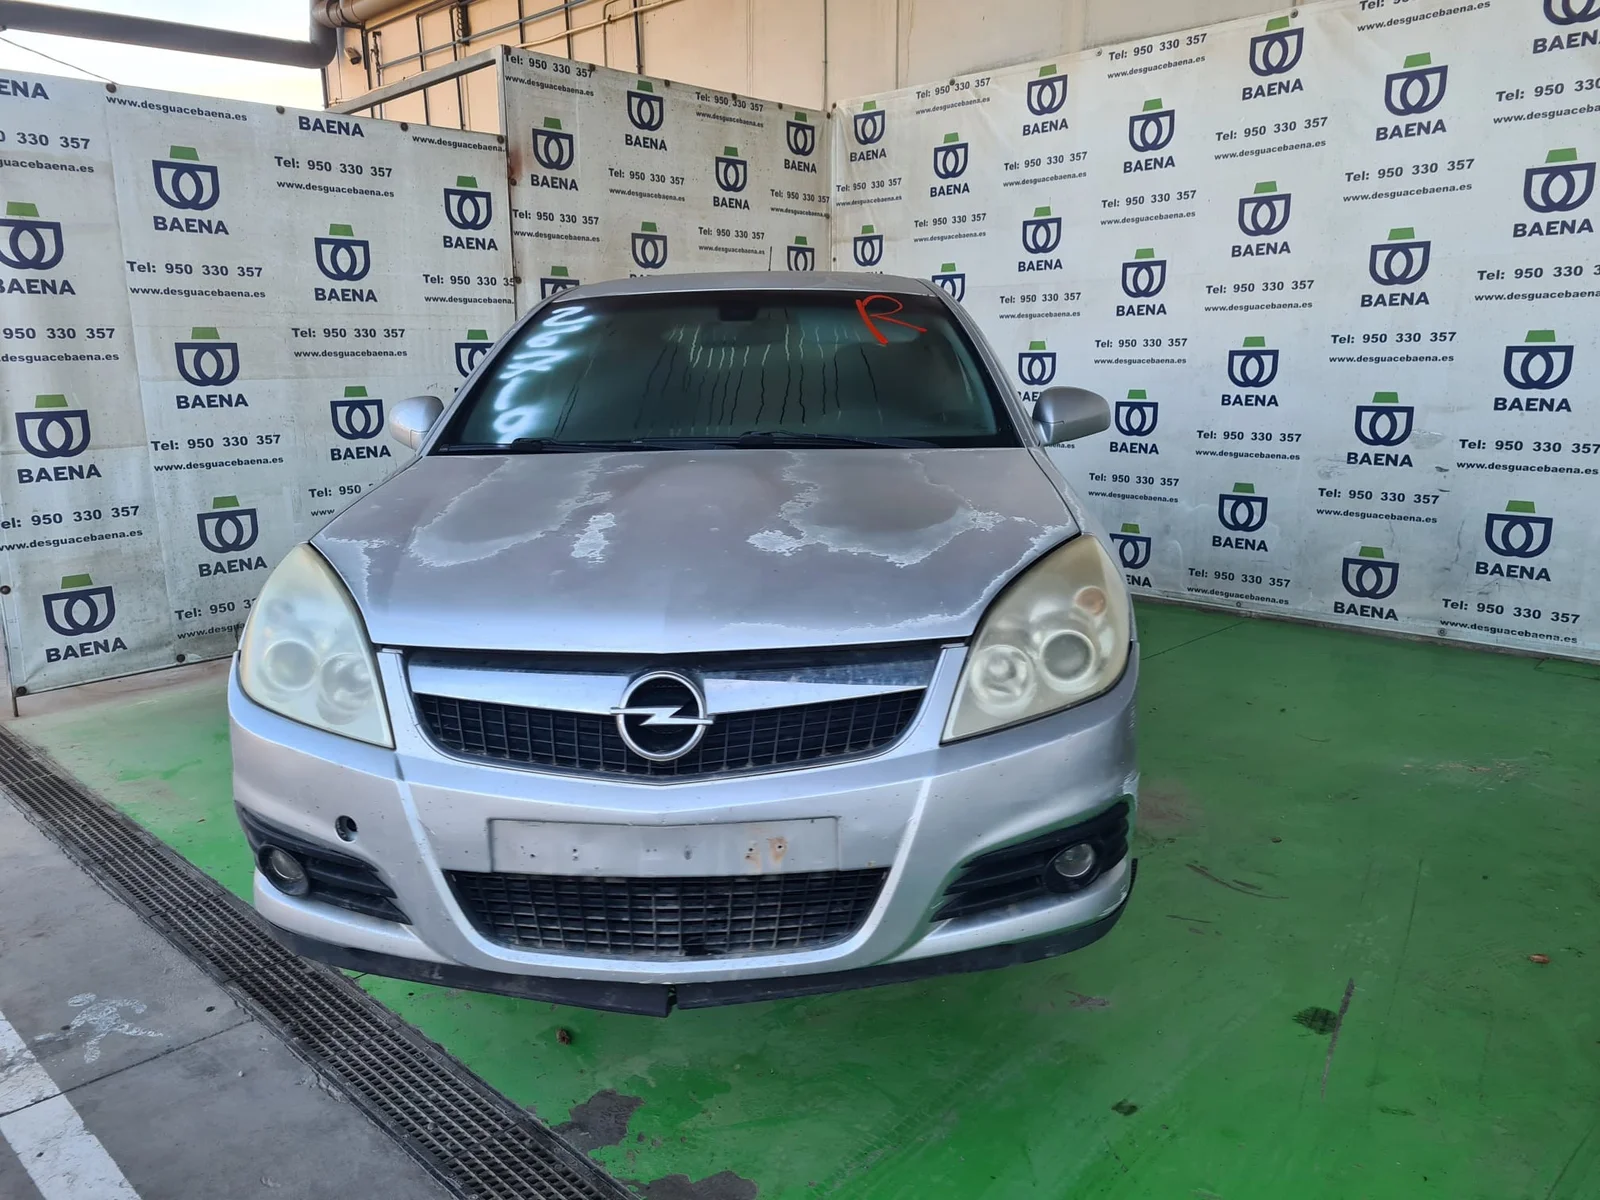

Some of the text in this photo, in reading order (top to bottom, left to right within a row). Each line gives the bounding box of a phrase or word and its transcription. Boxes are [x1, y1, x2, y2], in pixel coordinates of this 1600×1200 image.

[1358, 2, 1490, 31] www.desguacebaena.es
[1109, 33, 1207, 60] Tel: 950 330 357
[1533, 29, 1600, 54] BAEN
[1108, 56, 1205, 78] www.desguacebaena.es
[1242, 78, 1303, 100] BAENA
[1496, 78, 1600, 102] Tel: 950 330
[106, 96, 247, 121] www.desguacebaena.es
[298, 116, 364, 137] BAENA
[1023, 118, 1068, 136] BAENA
[1216, 117, 1328, 141] Tel: 950 330 357
[1376, 119, 1446, 141] BAENA
[625, 134, 667, 151] BAENA
[1214, 141, 1326, 160] www.desguacebaena.es
[850, 148, 886, 162] BAENA
[1004, 152, 1087, 170] Tel: 950 330 357
[274, 156, 392, 178] Tel: 950 330 357
[784, 159, 817, 174] BAENA
[1124, 156, 1175, 173] BAENA
[1345, 159, 1474, 182] Tel: 950 330 357
[531, 174, 578, 191] BAENA
[608, 168, 684, 185] Tel: 950 330 357
[1003, 172, 1086, 186] www.desguacebaena.es
[277, 182, 394, 197] www.desguacebaena.es
[930, 182, 970, 197] BAENA
[1343, 184, 1472, 202] www.desguacebaena.es
[713, 196, 750, 210] BAENA
[1102, 190, 1196, 208] Tel: 950 330 357
[512, 209, 599, 225] Tel: 950 330 357
[1101, 212, 1195, 225] www.desguacebaena.es
[153, 216, 229, 235] BAENA
[1513, 218, 1594, 238] BAENA
[443, 236, 498, 251] BAENA
[1232, 242, 1290, 258] BAENA
[126, 261, 262, 277] Tel: 950 330 357
[1018, 259, 1062, 272] BAENA
[1477, 266, 1583, 280] Tel: 950 330
[130, 287, 265, 298] www.desguacebaena.es
[314, 288, 378, 302] BAENA
[1206, 280, 1314, 294] Tel: 950 330 357
[1205, 302, 1312, 312] www.desguacebaena.es
[1361, 292, 1429, 307] BAENA
[1116, 304, 1166, 316] BAENA
[3, 328, 115, 339] 950 330 357
[291, 328, 405, 338] Tel: 950 330 357
[1331, 332, 1456, 344] Tel: 950 330 357
[1095, 338, 1187, 348] Tel: 950 330 357
[294, 350, 407, 358] www.desguacebaena.es
[1329, 354, 1454, 364] www.desguacebaena.es
[176, 394, 248, 409] BAENA
[1221, 394, 1278, 406] BAENA
[1494, 397, 1572, 412] BAENA
[150, 434, 280, 451] Tel: 950 330 357
[1197, 430, 1302, 442] Tel: 950 330 357
[330, 445, 391, 461] BAENA
[1110, 442, 1159, 454] BAENA
[1459, 439, 1600, 454] Tel: 950 330 357
[1196, 450, 1300, 460] www.desguacebaena.es
[1346, 452, 1413, 467] BAENA
[154, 458, 283, 471] www.desguacebaena.es
[1457, 462, 1598, 474] www.desguacebaena.es
[17, 464, 102, 484] BAENA
[1089, 473, 1179, 486] Tel: 950 330 357
[1088, 492, 1178, 502] www.desguacebaena.es
[1318, 488, 1439, 504] Tel: 950 330 357
[31, 506, 139, 526] 950 330 357
[1316, 509, 1437, 523] www.desguacebaena.es
[1212, 535, 1268, 552] BAENA
[198, 556, 268, 577] BAENA
[1475, 561, 1551, 582] BAENA
[1188, 568, 1290, 588] Tel: 950 330 357
[1187, 587, 1289, 605] www.desguacebaena.es
[174, 608, 202, 621] Tel:
[210, 602, 235, 614] 950
[1334, 601, 1398, 621] BAENA
[1442, 598, 1580, 624] Tel: 950 330 357
[1440, 620, 1577, 643] www.desguacebaena.es
[46, 637, 128, 663] BAENA
